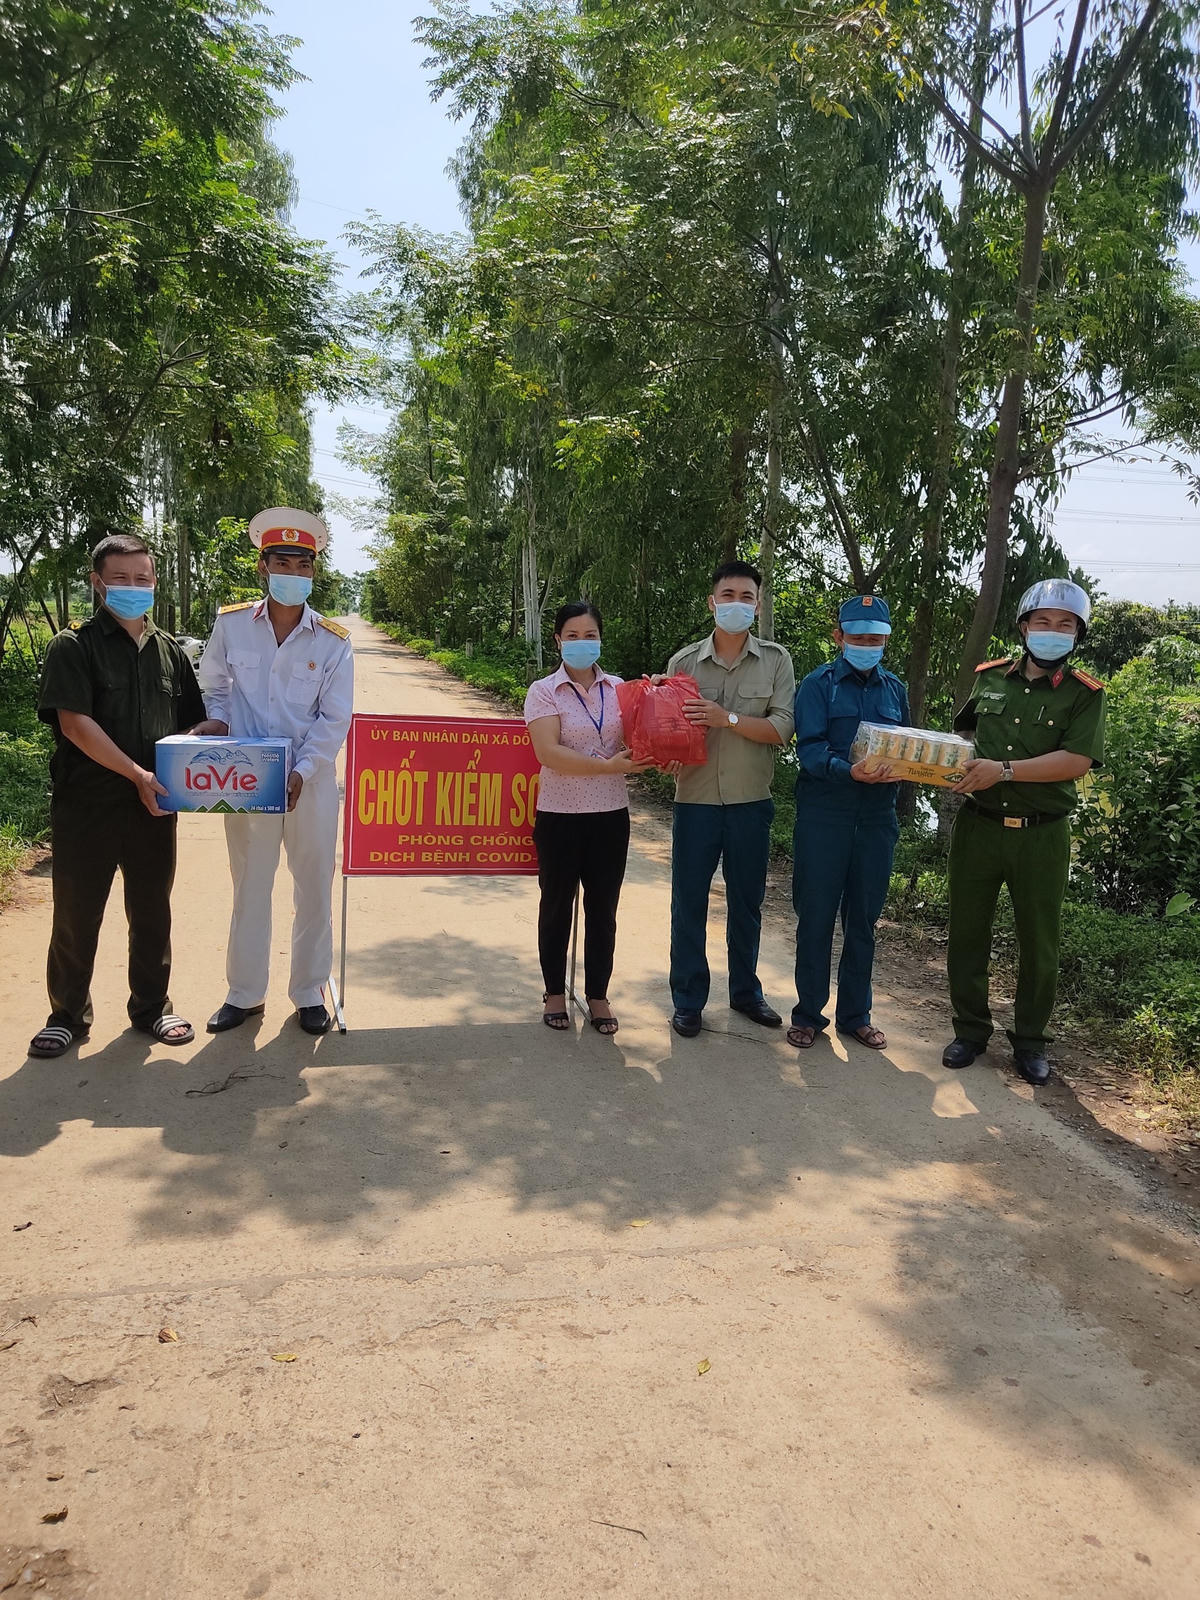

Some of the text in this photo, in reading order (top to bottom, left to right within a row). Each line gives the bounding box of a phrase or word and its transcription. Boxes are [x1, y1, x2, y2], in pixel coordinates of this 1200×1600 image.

[370, 725, 389, 741] ỦY
[392, 730, 419, 742] BAN
[422, 730, 458, 743] NHÂN
[462, 731, 489, 744] DÂN
[491, 731, 509, 745] XÃ
[185, 765, 258, 791] laVie
[358, 750, 429, 826] CHỐT
[435, 749, 503, 827] KIỂM
[398, 831, 534, 846] PHÒNG CHỐNG
[369, 851, 415, 865] DỊCH
[421, 849, 470, 865] BỆNH
